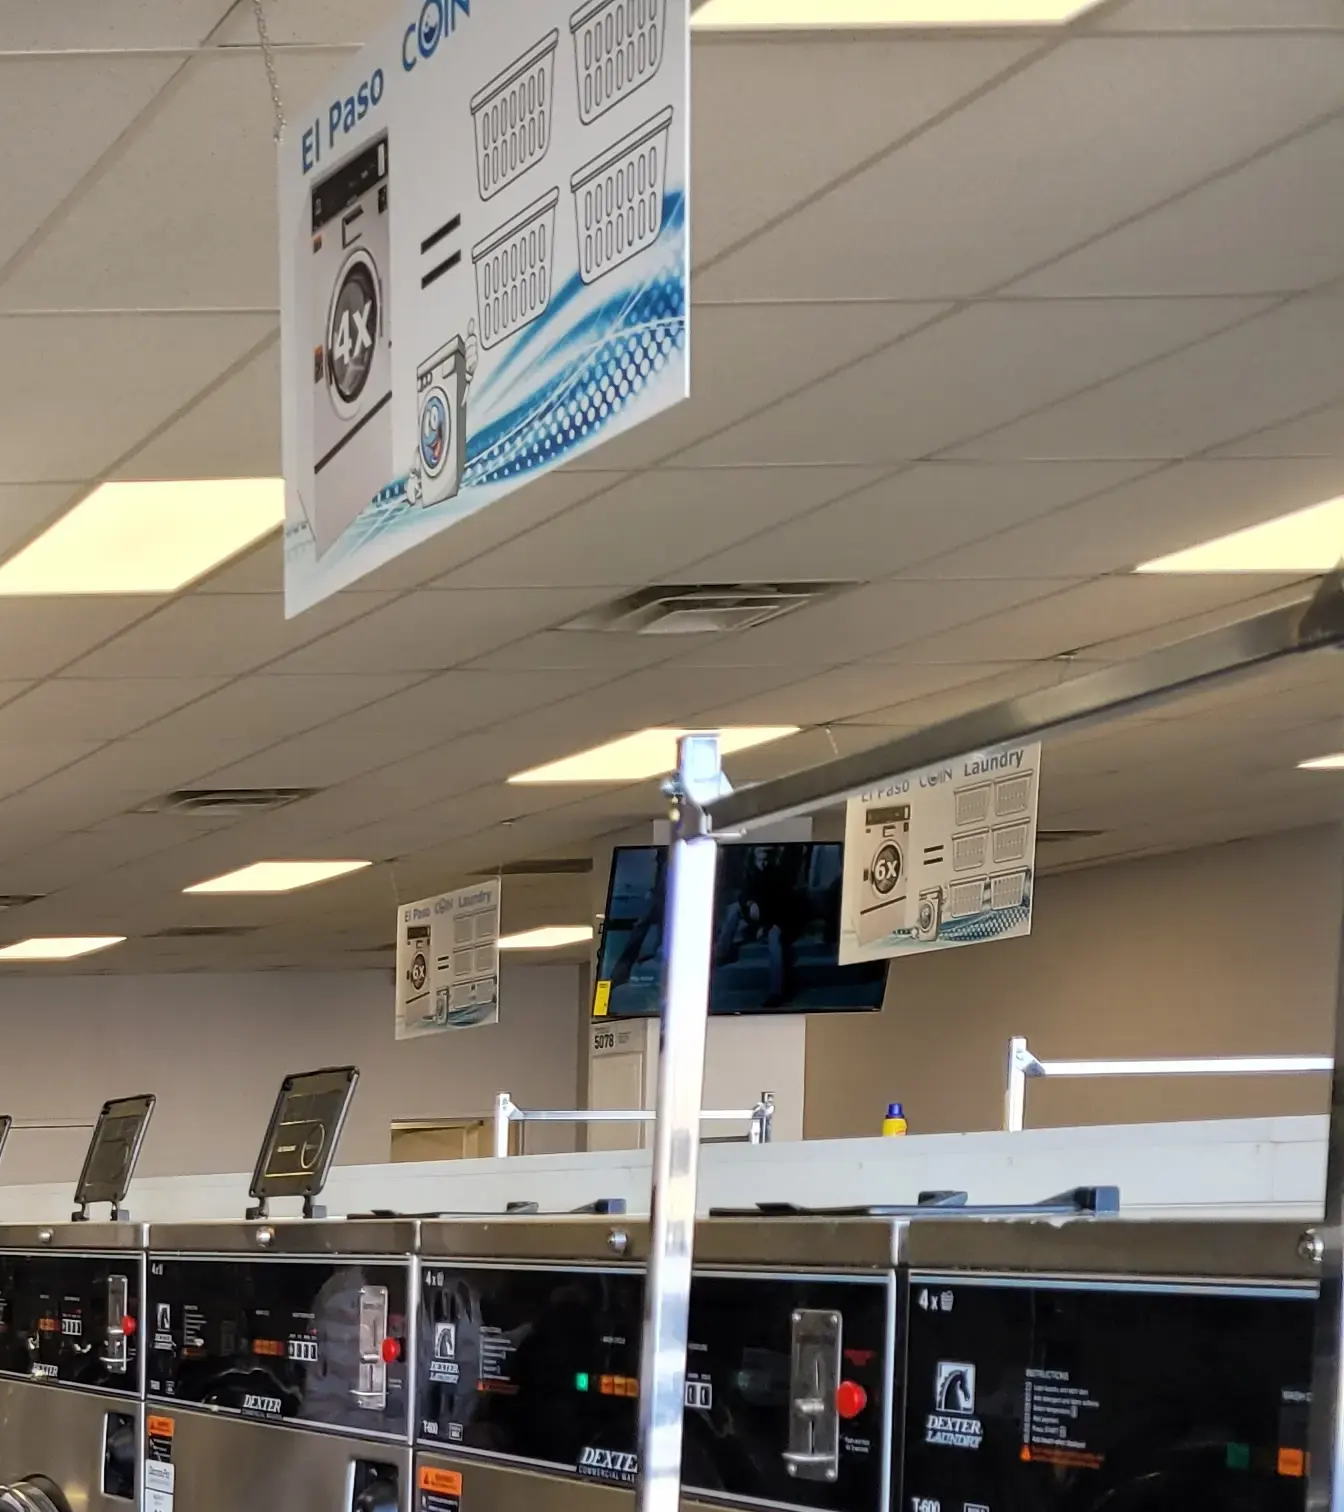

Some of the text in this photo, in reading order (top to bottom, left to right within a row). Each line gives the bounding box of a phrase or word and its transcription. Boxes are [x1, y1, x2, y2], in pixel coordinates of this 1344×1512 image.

[302, 117, 320, 176] El
[329, 68, 384, 149] Paso
[963, 749, 1025, 777] Laundry
[404, 909, 411, 923] El
[413, 907, 431, 920] Paso
[458, 889, 491, 908] Laundry
[918, 1288, 929, 1311] 4
[243, 1393, 282, 1413] DEXTER
[926, 1413, 981, 1436] DEXTER
[579, 1446, 639, 1474] DEXTE
